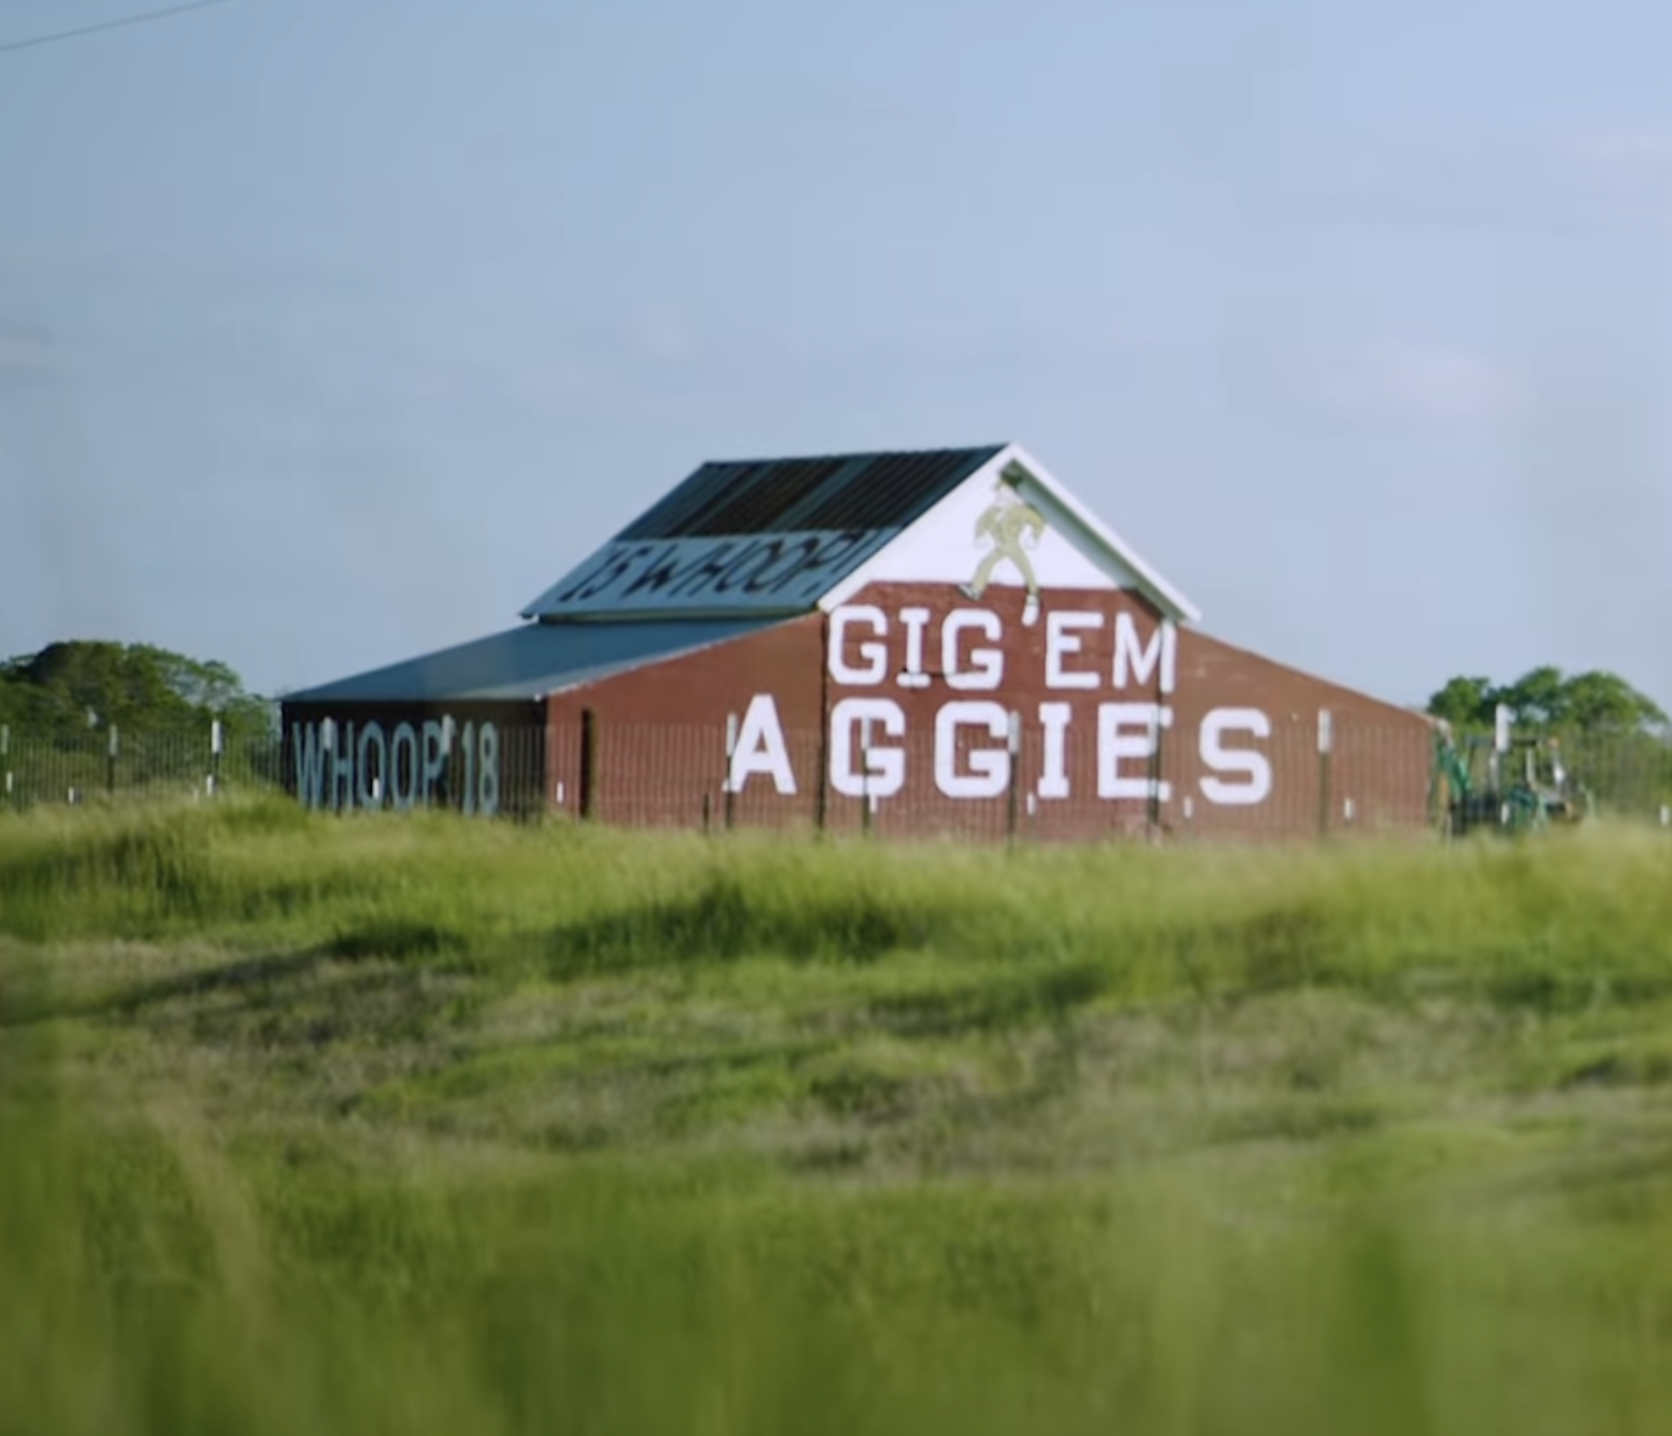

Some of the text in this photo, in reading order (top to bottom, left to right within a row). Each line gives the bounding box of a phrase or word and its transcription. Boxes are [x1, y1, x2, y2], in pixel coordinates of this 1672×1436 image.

[827, 604, 1003, 690] GIG
[291, 720, 446, 815] WHOOP
[722, 693, 1272, 805] AGGIES
